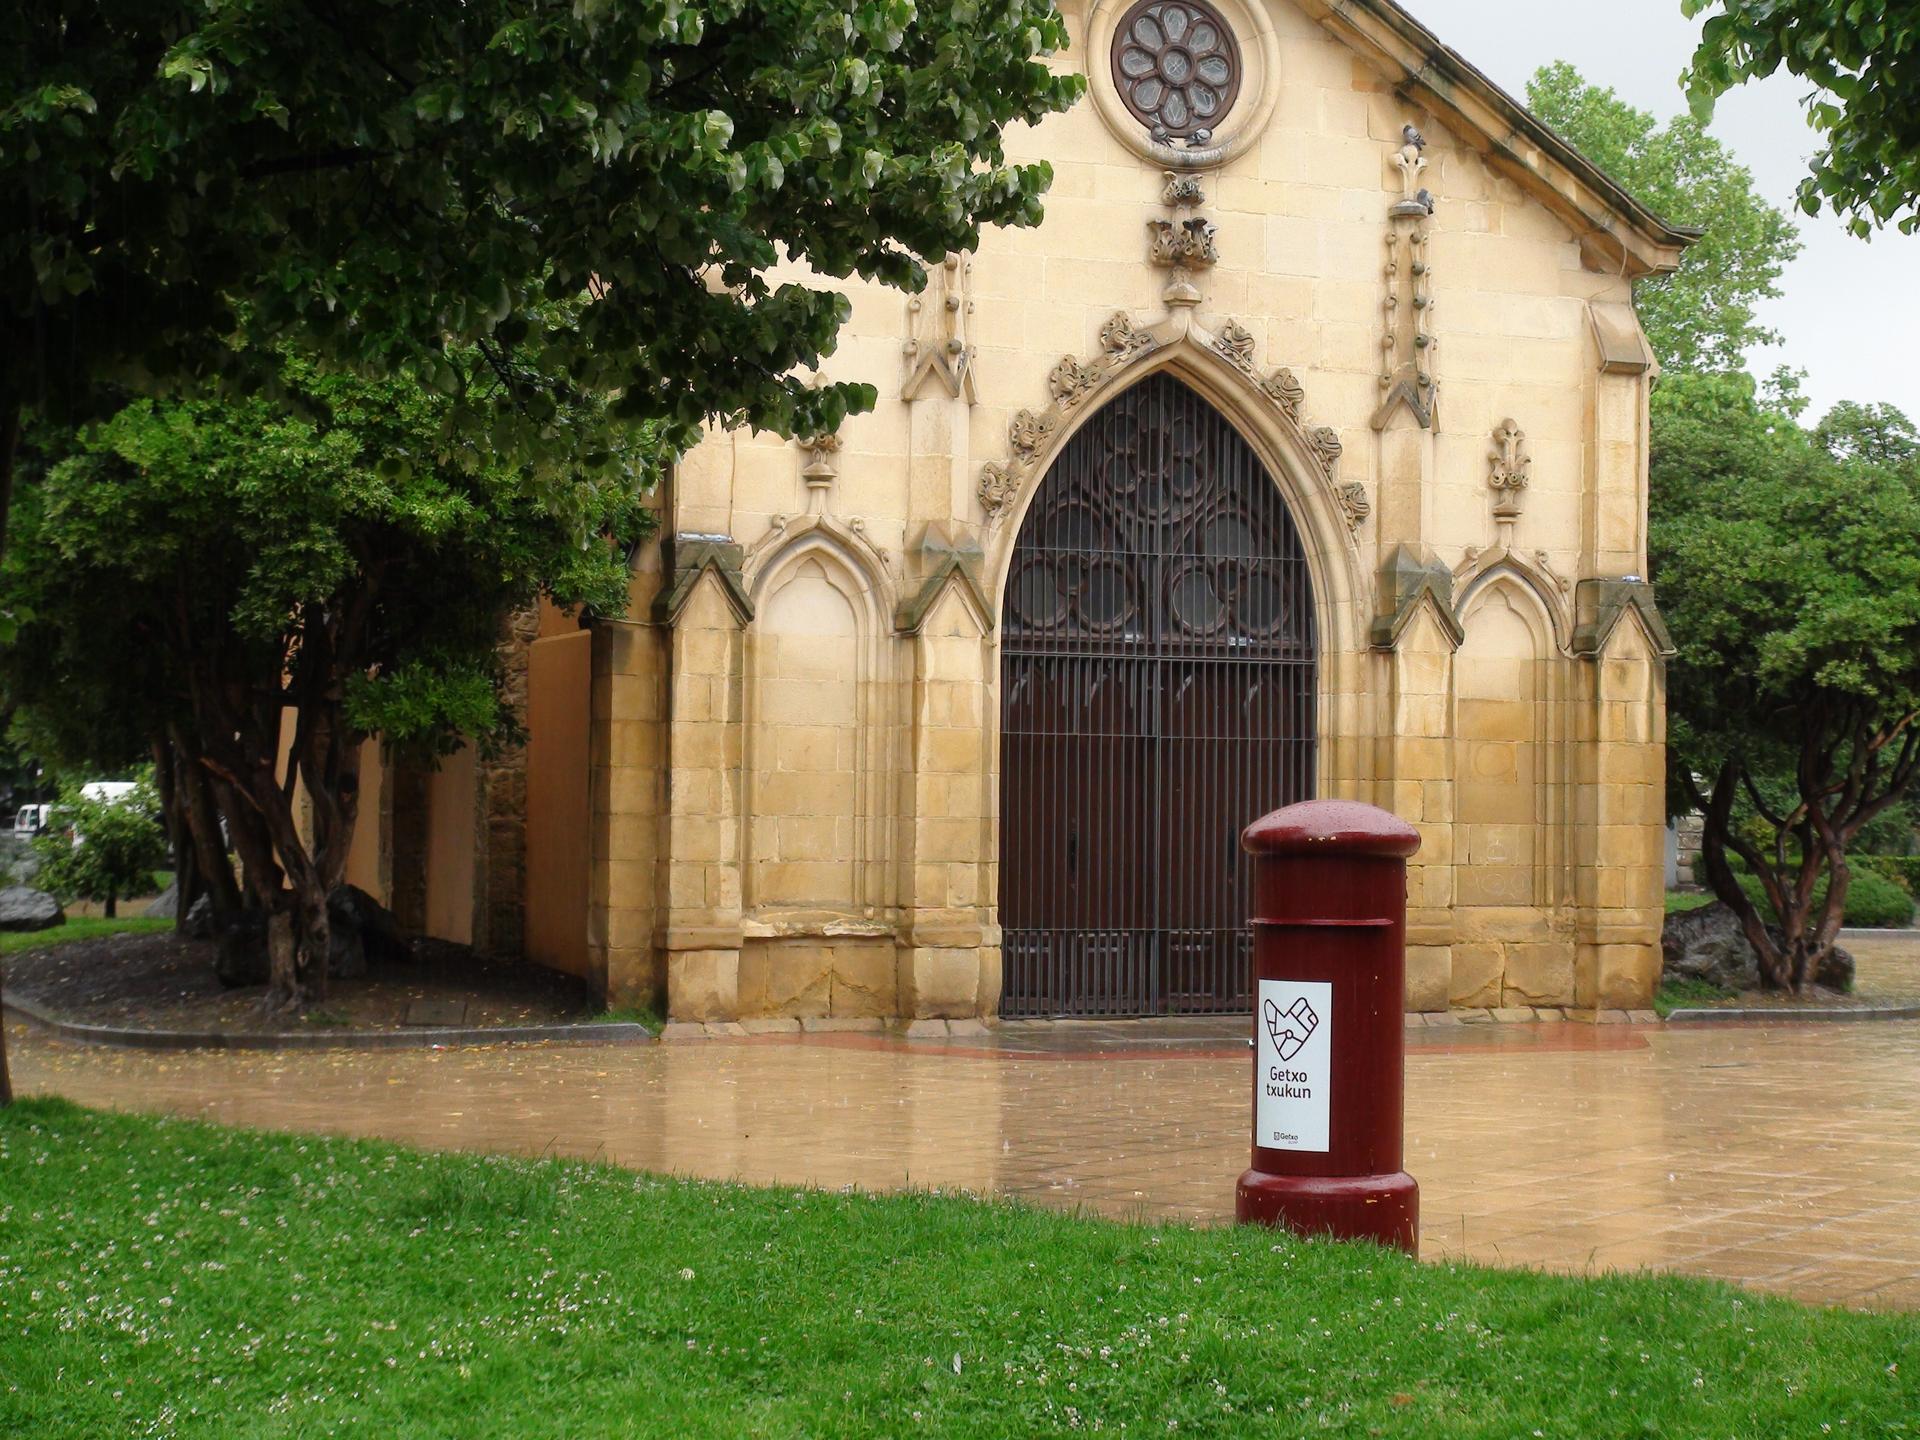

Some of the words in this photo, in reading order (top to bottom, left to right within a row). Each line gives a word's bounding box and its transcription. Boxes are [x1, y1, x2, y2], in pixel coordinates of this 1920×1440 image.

[1270, 1066, 1307, 1082] Getxo
[1266, 1083, 1311, 1099] txukun
[1280, 1132, 1299, 1141] Getxo
